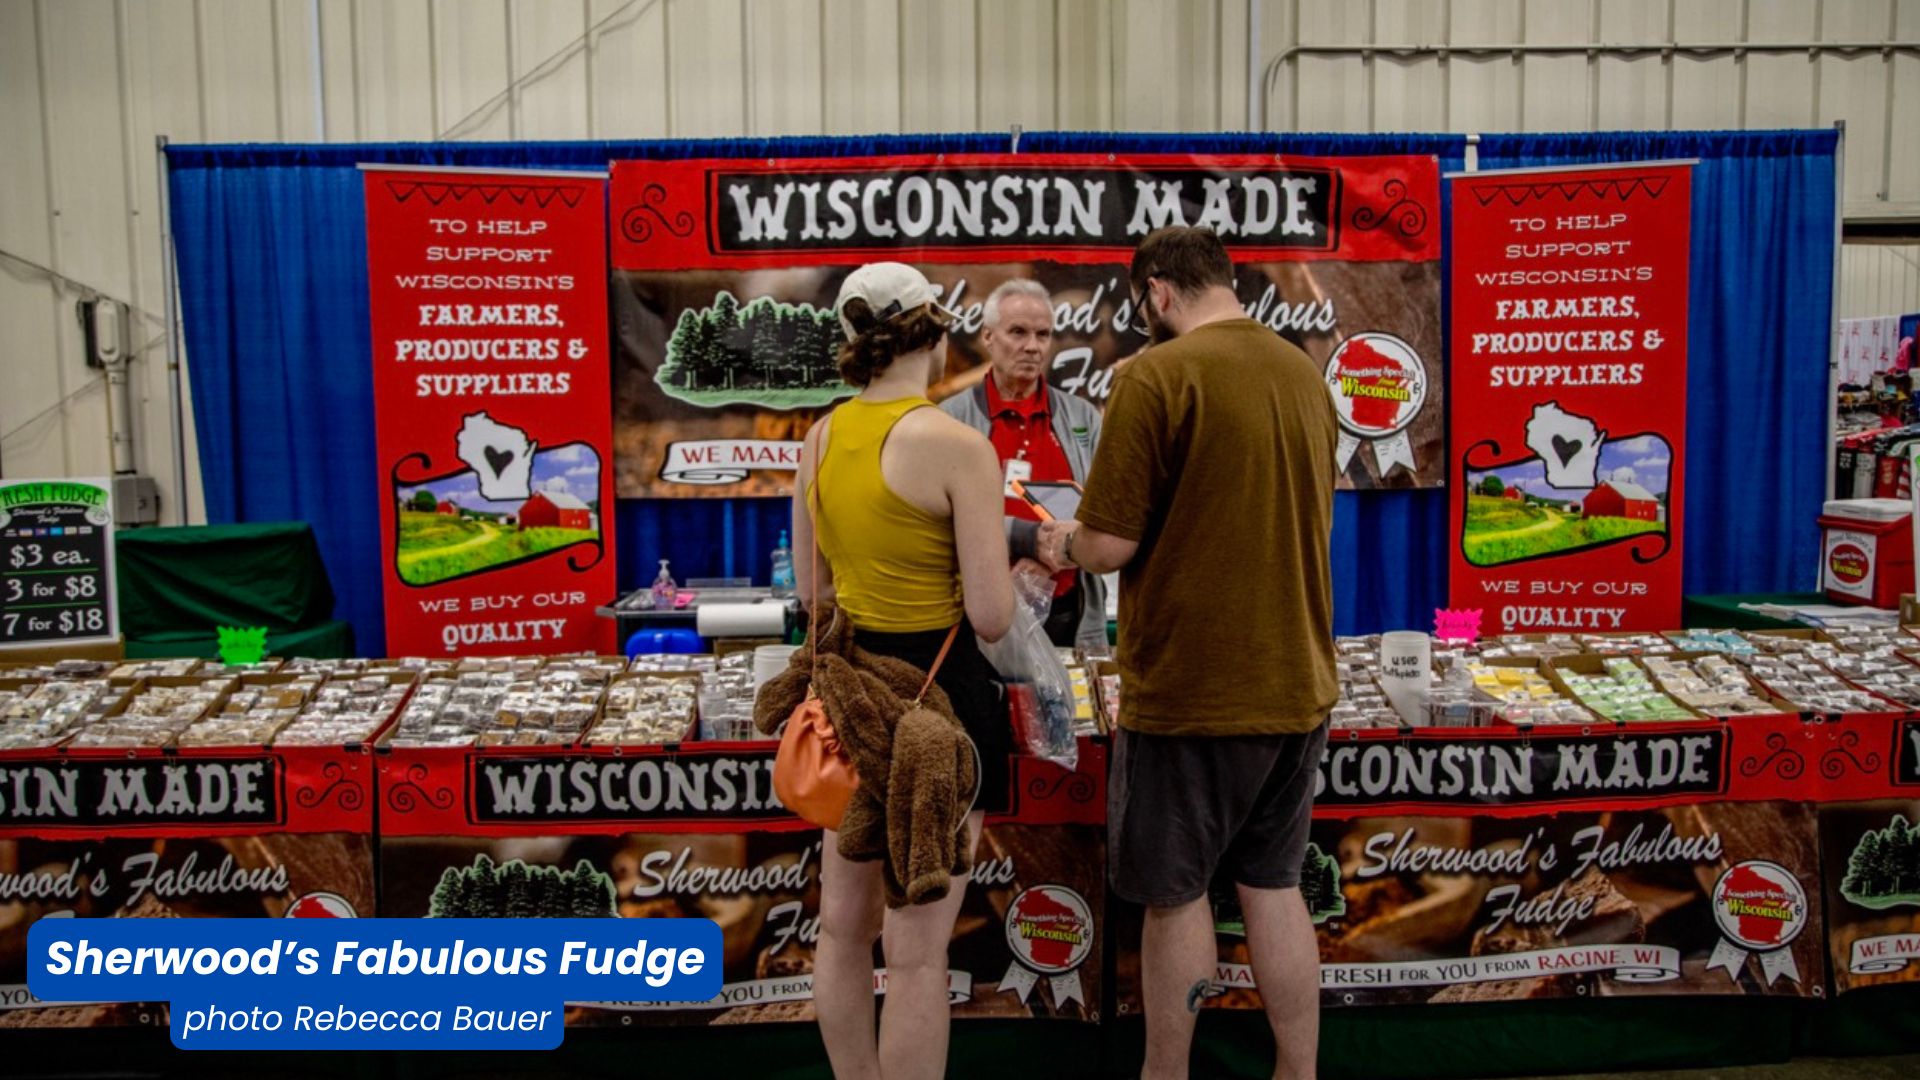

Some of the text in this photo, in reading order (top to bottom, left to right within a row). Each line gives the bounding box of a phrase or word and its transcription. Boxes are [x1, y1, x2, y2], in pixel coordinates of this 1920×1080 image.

[729, 174, 1317, 241] WISCONSIN MADE
[429, 219, 547, 235] TO HELP
[1510, 213, 1627, 232] TO HELP
[427, 246, 552, 263] SUPPORT
[1505, 241, 1631, 259] SUPPORT
[396, 275, 574, 290] WISCONSIN'S
[1476, 267, 1653, 285] WISCONSIN'S
[419, 304, 564, 328] FARMERS,
[1496, 296, 1640, 321] FARMERS,
[395, 339, 588, 362] PRODUCERS &
[1472, 329, 1664, 354] PRODUCERS &
[416, 373, 571, 397] SUPPLIERS
[1490, 363, 1644, 387] SUPPLIERS
[1341, 376, 1410, 401] Wisconsin
[681, 446, 802, 464] WE MAK
[10, 544, 91, 569] $3 ea.
[6, 575, 97, 602] 3 for $8
[1481, 580, 1648, 595] WE BUY OUR
[419, 591, 586, 613] WE BUY OUR
[3, 608, 103, 636] 7 for $18
[1501, 605, 1626, 631] QUALITY
[442, 618, 568, 651] QUALITY
[1553, 735, 1711, 791] MADE
[97, 763, 266, 817] MADE
[1357, 823, 1724, 878] Sherwood's Fabulous
[122, 851, 289, 906] Fabulous
[633, 842, 823, 897] Sherwood'
[1485, 884, 1595, 936] Fudge
[1728, 898, 1793, 922] Wisconsin
[1020, 920, 1082, 945] Wisconsin
[1859, 941, 1887, 957] WE
[1321, 968, 1391, 984] FRESH
[1400, 968, 1430, 981] FOR
[1437, 963, 1478, 981] YOU
[1485, 958, 1531, 972] FROM
[1634, 948, 1661, 965] WI
[721, 985, 763, 1003] YOU
